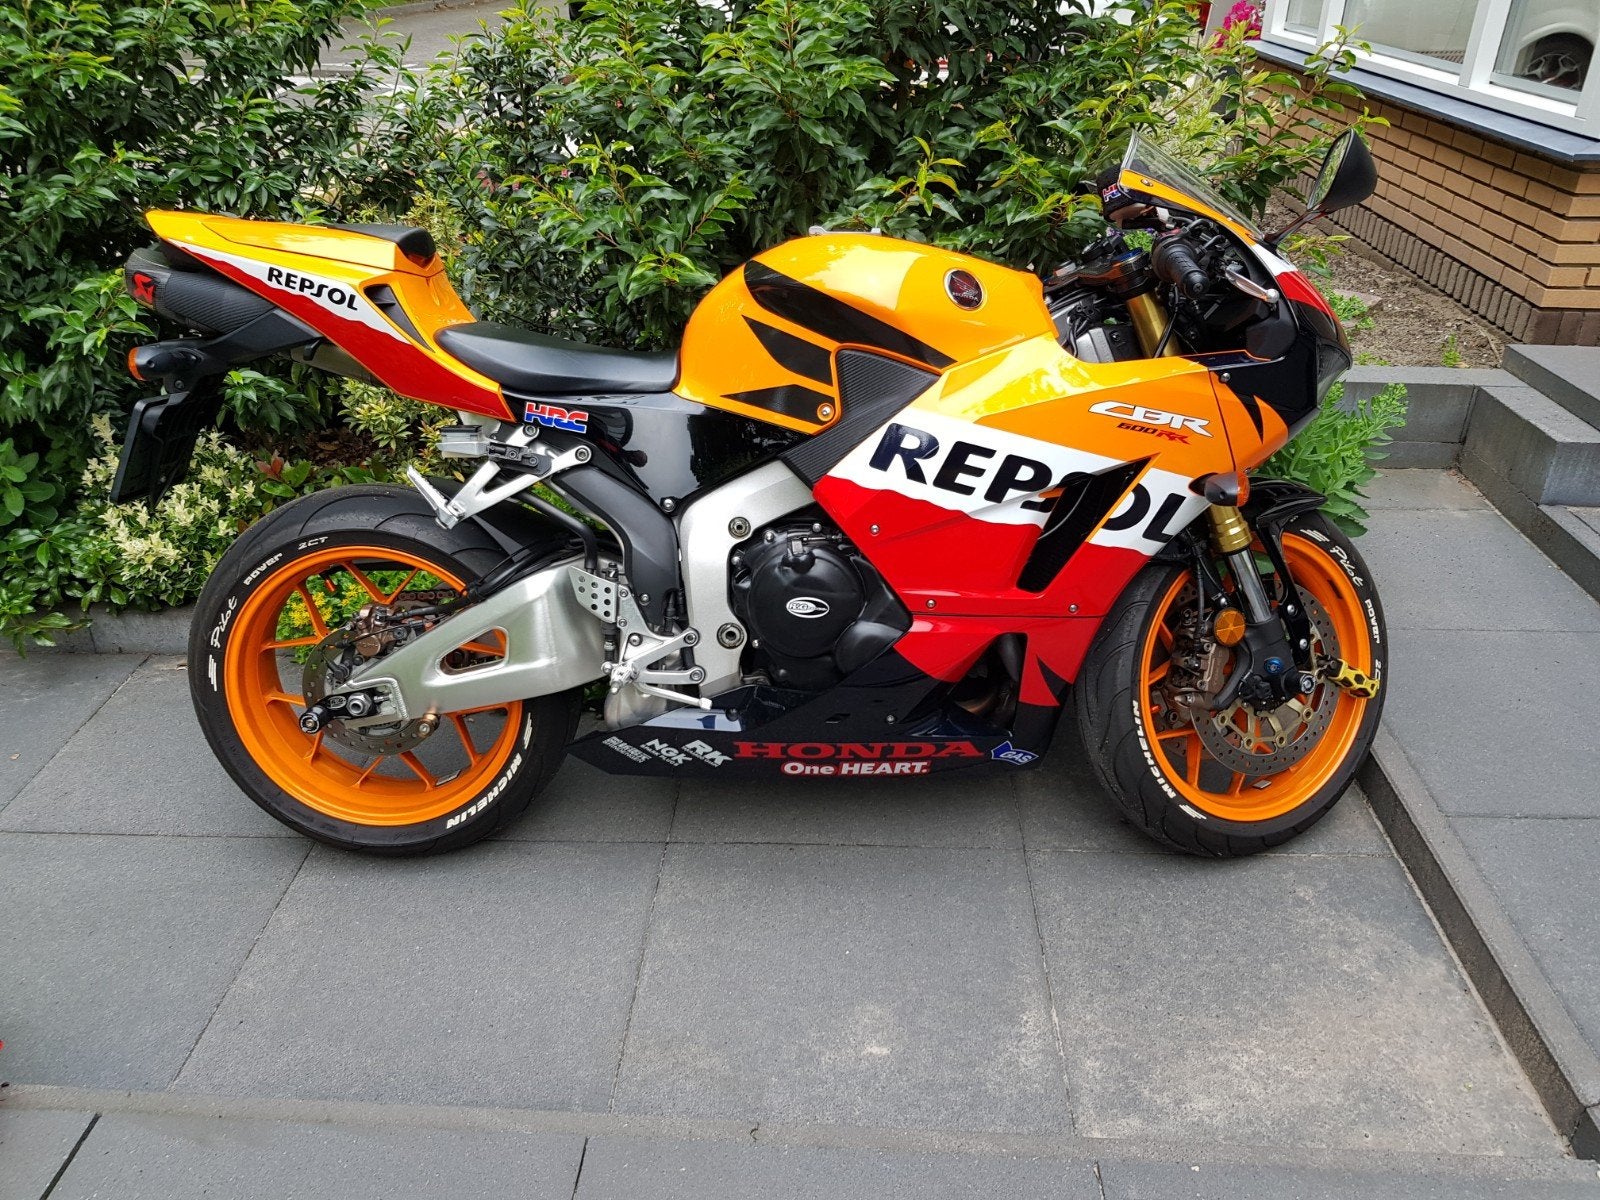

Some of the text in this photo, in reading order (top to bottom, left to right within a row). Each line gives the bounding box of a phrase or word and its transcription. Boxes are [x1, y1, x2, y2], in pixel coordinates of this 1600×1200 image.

[267, 266, 358, 311] REPSOL
[524, 401, 589, 434] HRC
[1088, 400, 1215, 438] CBR
[1116, 421, 1191, 446] 600RR
[1329, 545, 1364, 587] Pilot
[210, 595, 238, 649] Pilot
[297, 536, 329, 550] 2CT
[643, 738, 694, 765] NGK
[682, 739, 734, 766] RK
[734, 741, 985, 759] HONDA
[1000, 751, 1033, 763] GAS
[1132, 700, 1177, 799] MICHELIN
[784, 761, 929, 775] One HEART.
[446, 752, 522, 830] MICHELIN
